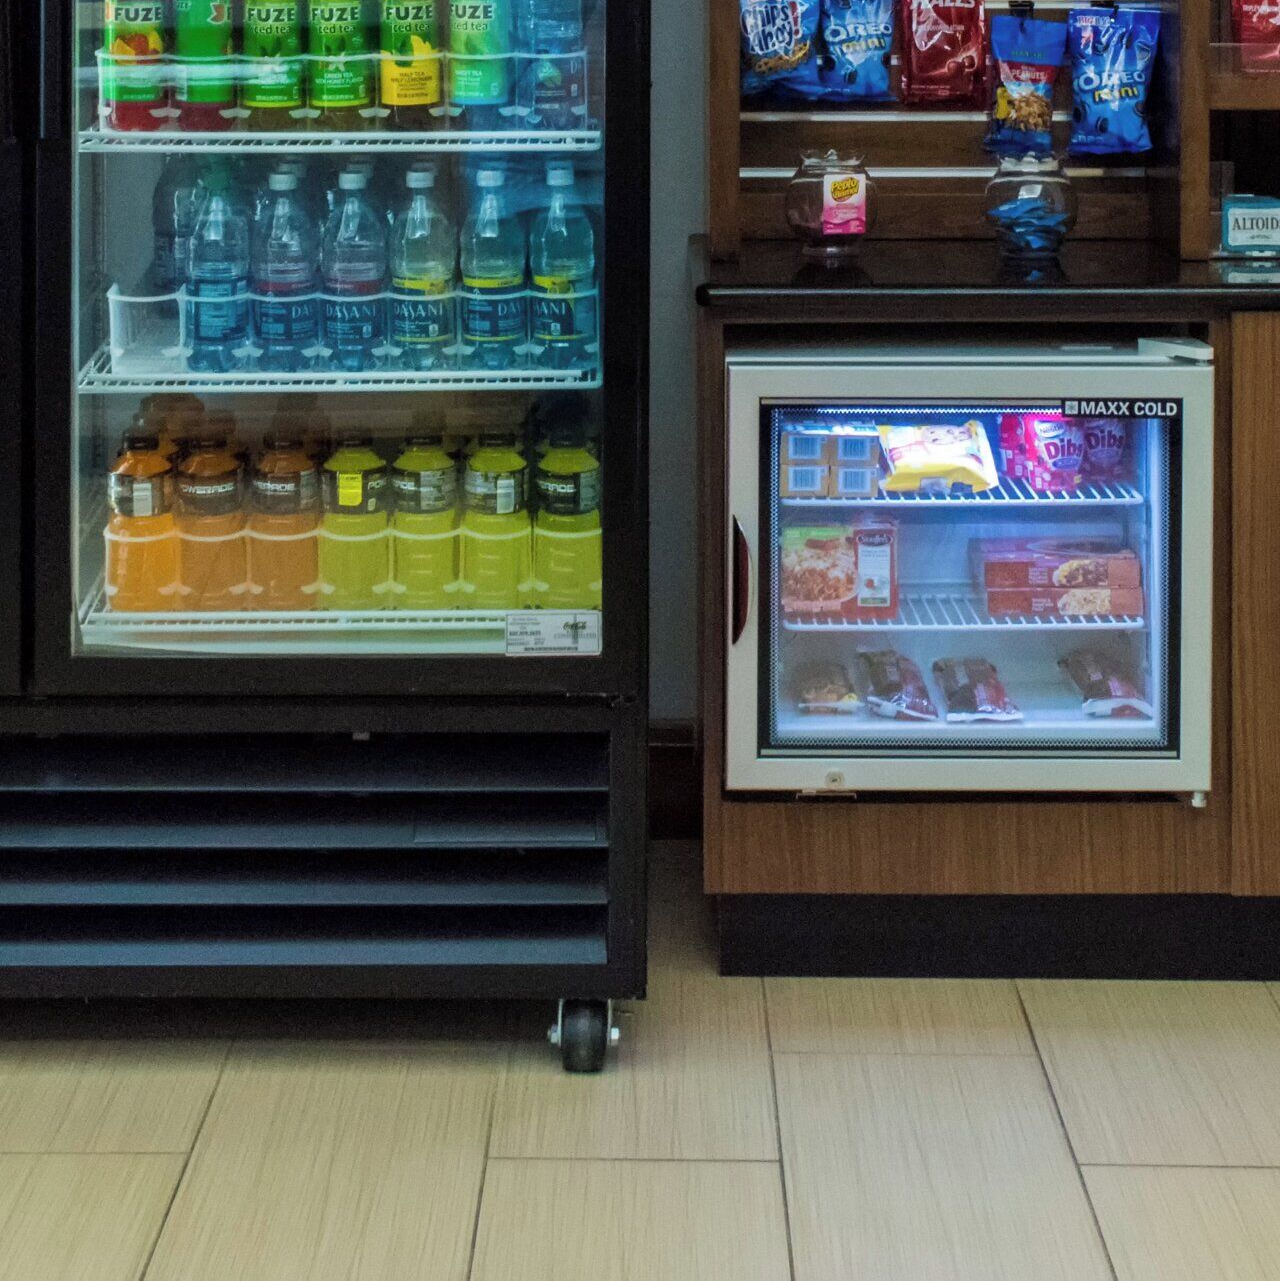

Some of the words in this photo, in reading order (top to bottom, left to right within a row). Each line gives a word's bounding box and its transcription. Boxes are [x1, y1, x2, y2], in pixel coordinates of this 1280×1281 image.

[114, 7, 162, 22] FUZE
[248, 8, 295, 22] FUZE
[311, 6, 360, 22] FUZE
[386, 6, 433, 20] FUZE
[473, 21, 488, 31] tea
[824, 22, 893, 43] OREO
[1078, 71, 1145, 91] OREO
[326, 304, 376, 321] DASANI
[394, 302, 443, 319] DASANI
[1080, 402, 1130, 416] MAXX
[1133, 402, 1178, 416] COLD
[1085, 430, 1125, 450] Dibs
[1044, 437, 1083, 460] Dibs
